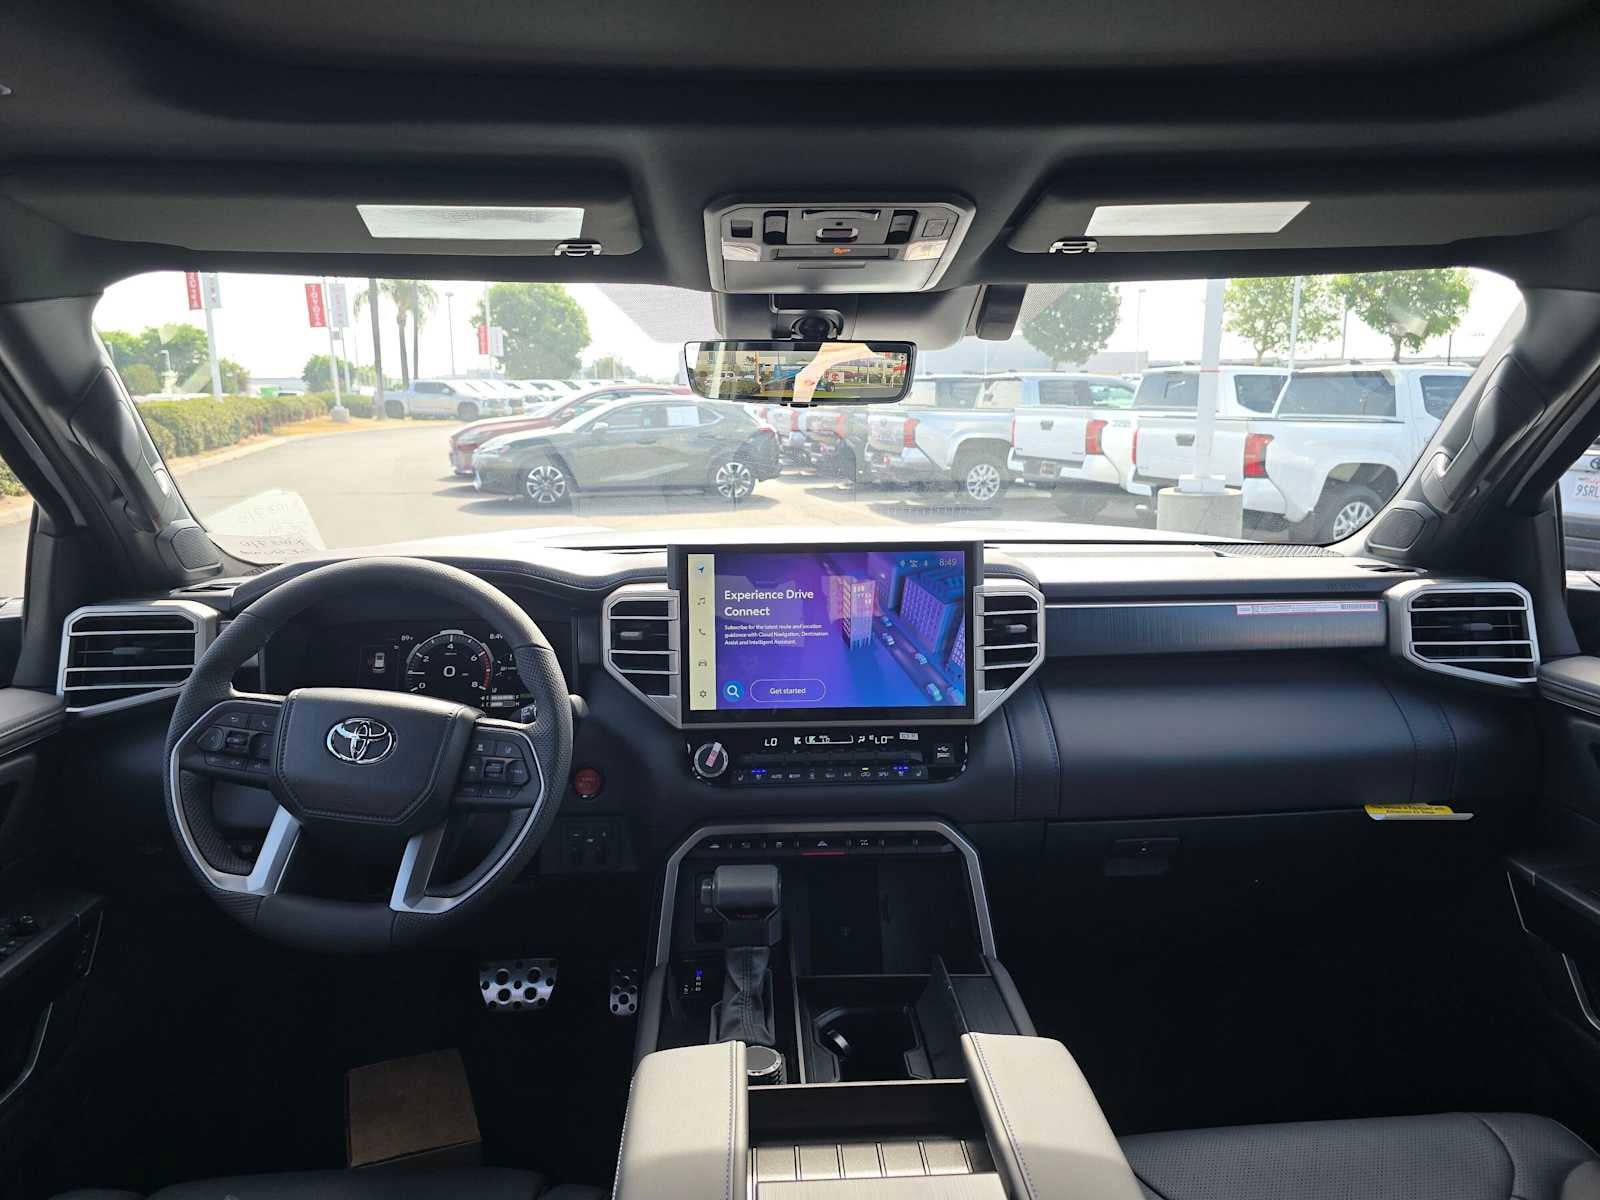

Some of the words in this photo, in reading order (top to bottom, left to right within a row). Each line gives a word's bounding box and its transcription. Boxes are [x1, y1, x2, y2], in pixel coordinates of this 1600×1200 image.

[724, 589, 784, 602] Experience
[786, 588, 814, 599] Drive
[724, 606, 771, 616] Connect
[764, 738, 778, 747] LO
